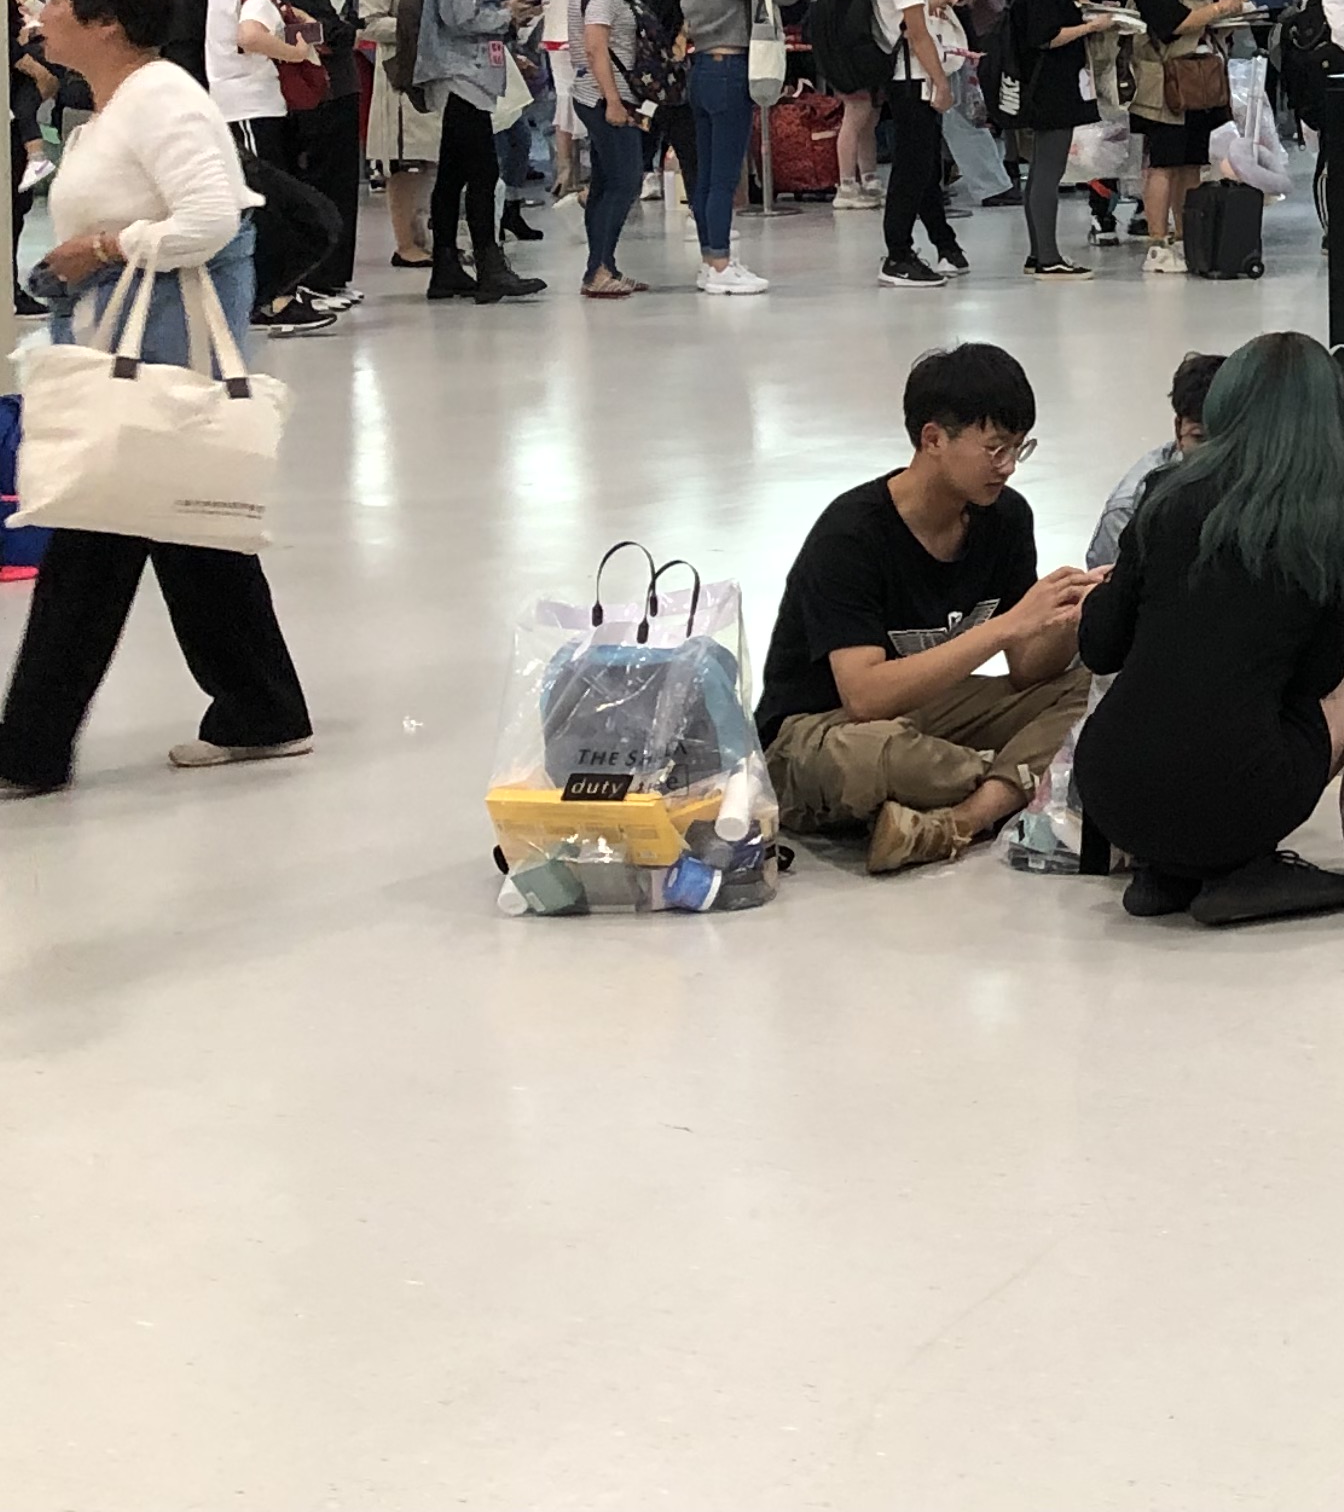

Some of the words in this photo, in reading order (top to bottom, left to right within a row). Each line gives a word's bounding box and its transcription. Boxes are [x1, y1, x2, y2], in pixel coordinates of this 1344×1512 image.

[999, 72, 1020, 115] NIKE
[578, 749, 619, 766] THE
[570, 777, 623, 798] duty
